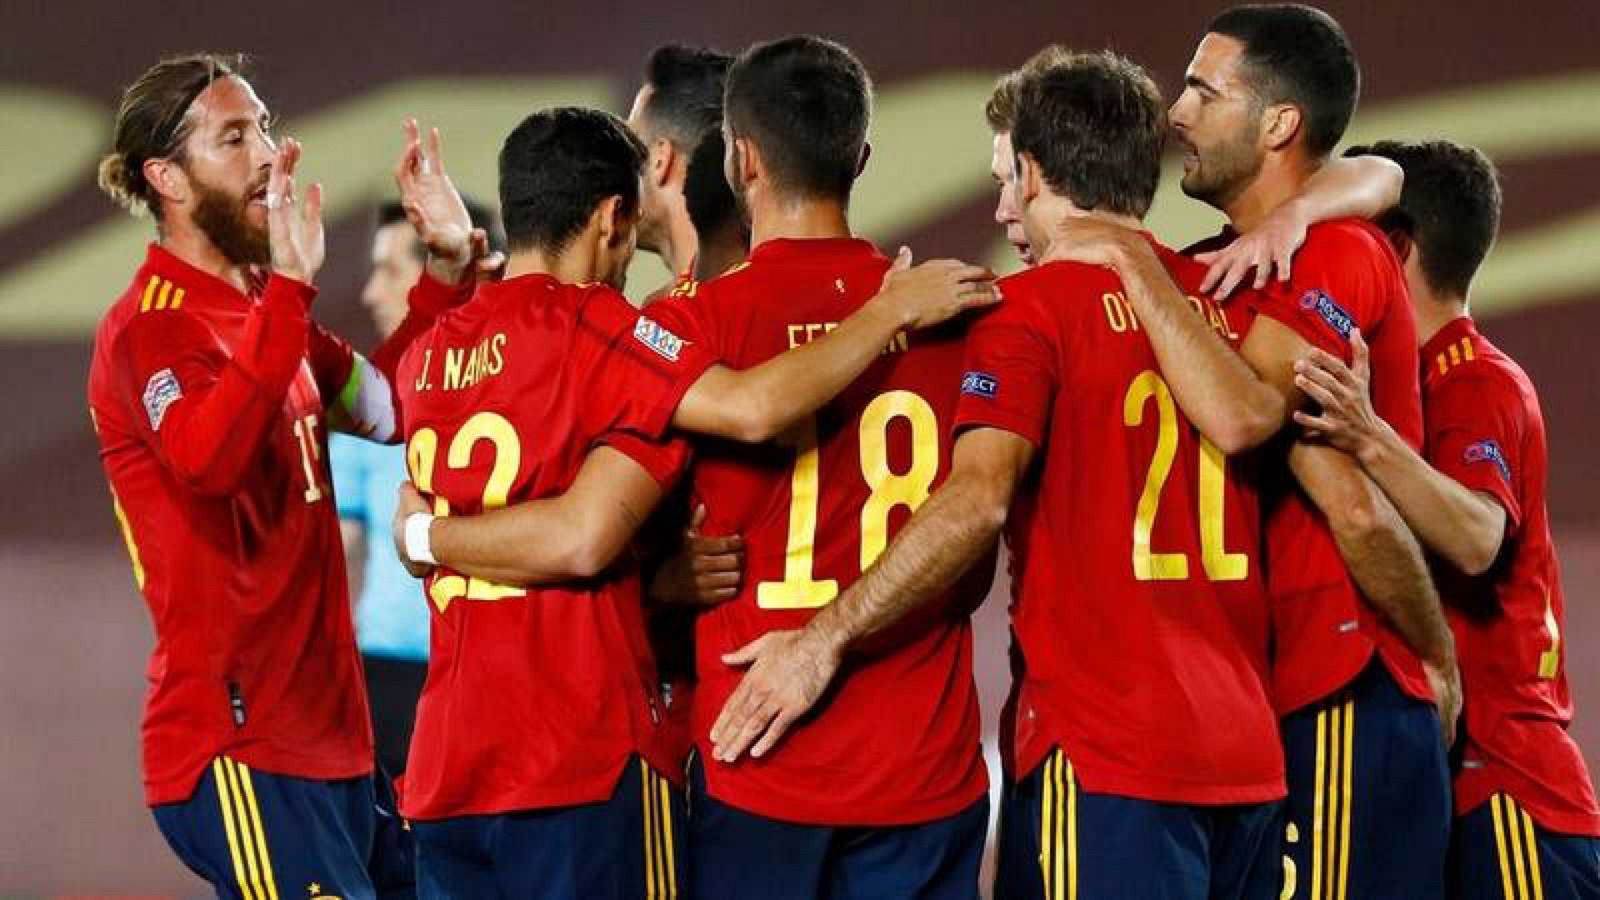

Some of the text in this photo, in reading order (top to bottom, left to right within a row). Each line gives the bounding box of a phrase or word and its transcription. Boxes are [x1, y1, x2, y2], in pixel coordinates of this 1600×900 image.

[415, 349, 433, 391] J.
[1124, 370, 1248, 581] 21
[757, 390, 938, 609] 18
